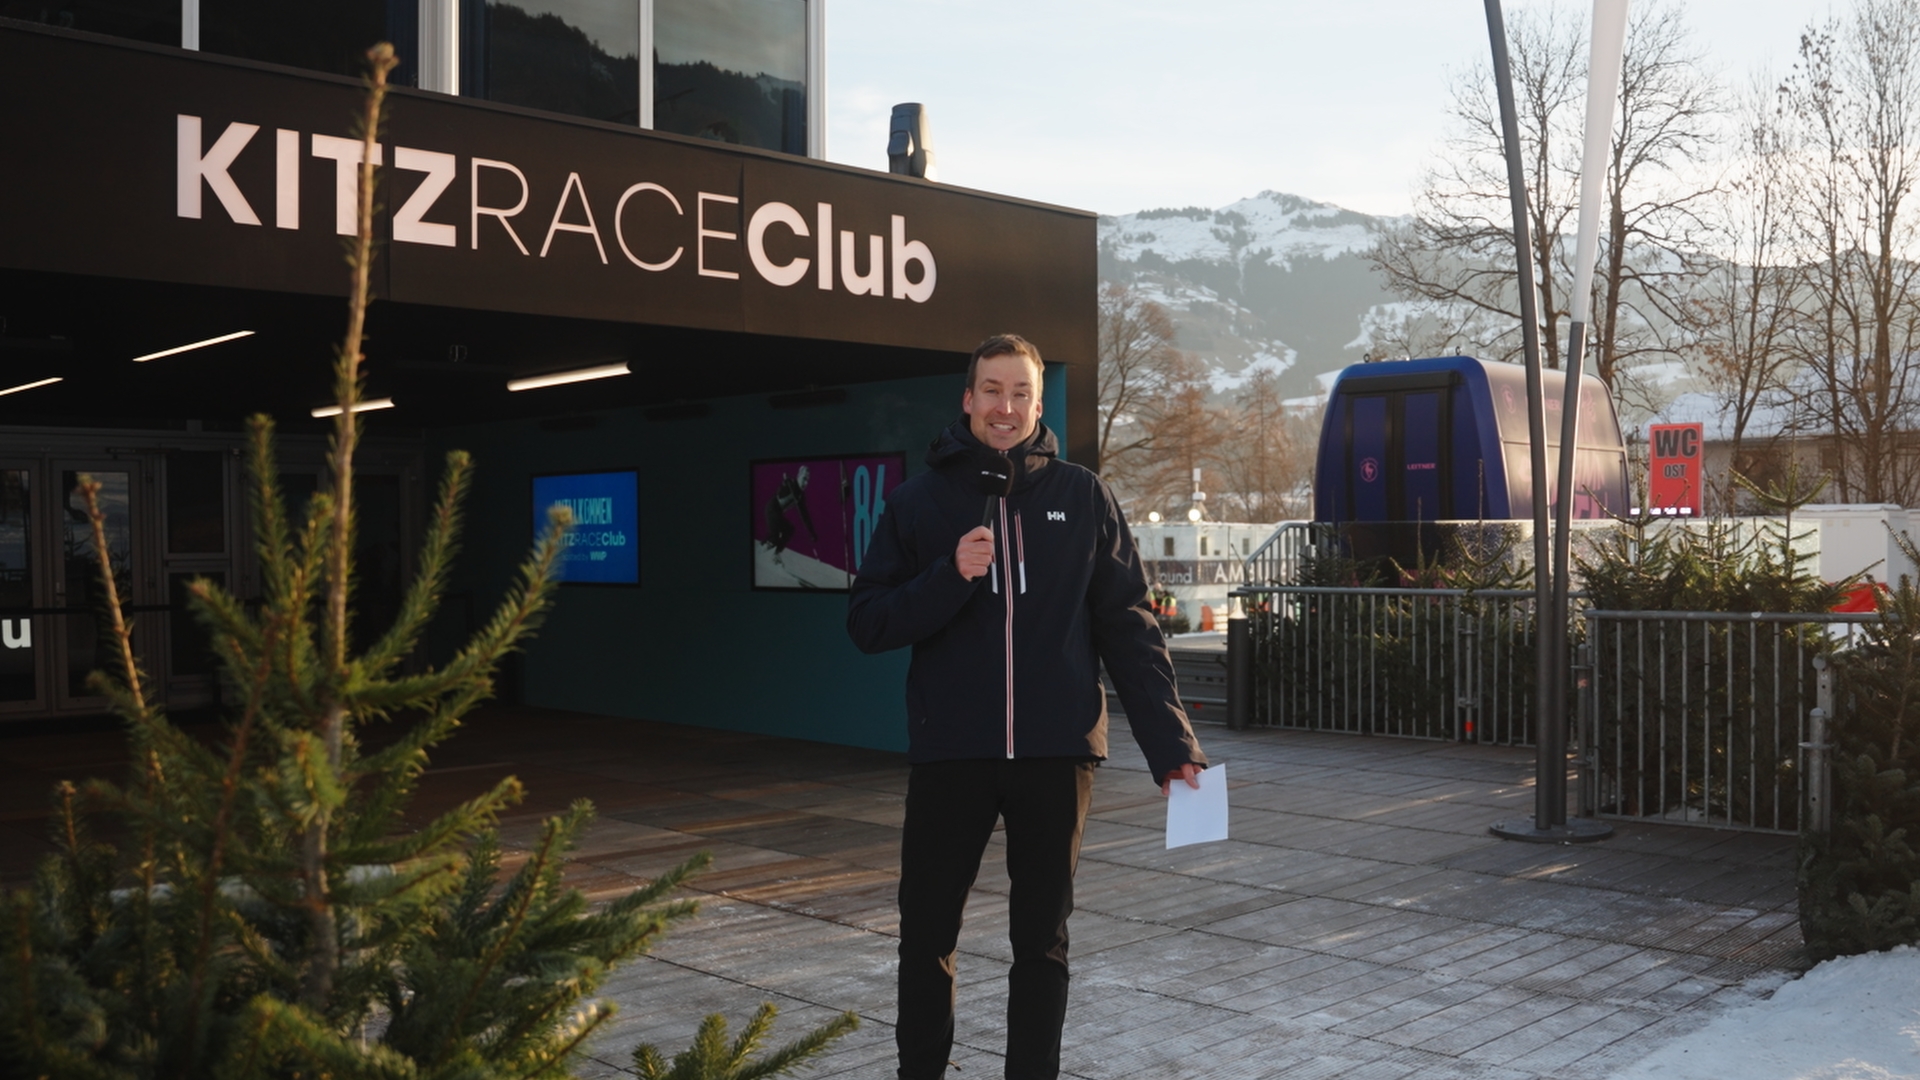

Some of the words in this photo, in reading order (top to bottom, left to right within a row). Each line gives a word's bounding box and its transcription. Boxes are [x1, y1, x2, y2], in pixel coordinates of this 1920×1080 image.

[177, 114, 938, 303] KITZRACEClub
[1655, 428, 1698, 458] WC
[1406, 462, 1436, 470] LEITNER
[1664, 464, 1687, 478] OST
[554, 497, 612, 525] LKOMMEN
[1046, 511, 1066, 522] HH
[556, 531, 626, 547] ITZRACEClub
[1155, 566, 1194, 584] ound
